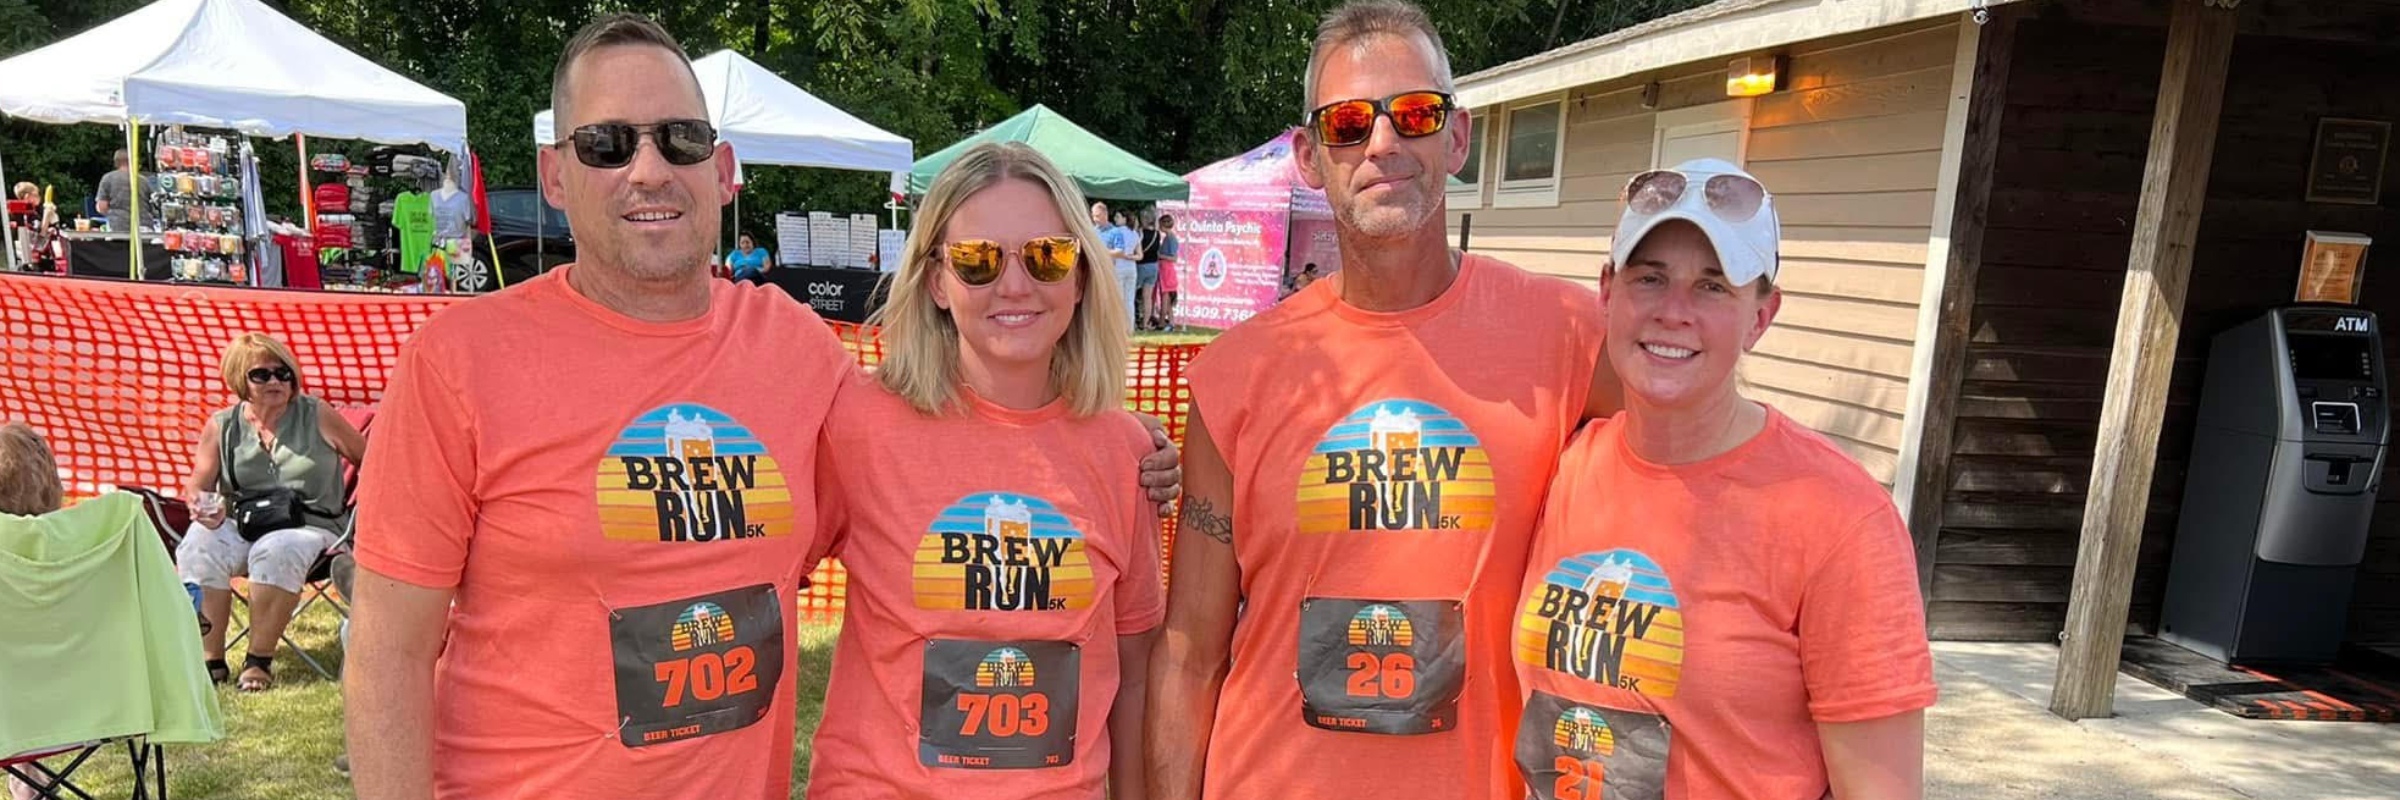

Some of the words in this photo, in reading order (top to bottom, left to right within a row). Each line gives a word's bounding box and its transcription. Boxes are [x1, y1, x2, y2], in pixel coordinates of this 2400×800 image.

[1190, 220, 1223, 232] Quinta
[1225, 220, 1261, 237] Psychic
[808, 281, 844, 296] color
[810, 298, 845, 311] STREET
[2334, 316, 2368, 332] ATM
[621, 455, 757, 490] BREW
[1325, 447, 1465, 484] BREW
[654, 490, 746, 542] RUN
[747, 524, 765, 537] 5K
[1350, 481, 1440, 530] RUN
[1440, 516, 1460, 529] 5K
[941, 532, 1072, 567] BREW
[965, 564, 1050, 611] RUN
[1049, 598, 1067, 610] 5K
[1538, 584, 1661, 639] BREW
[1546, 620, 1626, 688] RUN
[1619, 676, 1640, 692] 5K
[655, 646, 757, 707] 702
[1347, 652, 1415, 699] 26
[670, 725, 700, 737] TICKET
[957, 693, 1049, 737] 703
[1339, 718, 1367, 728] TICKET
[962, 756, 990, 766] TICKET
[1554, 756, 1604, 800] 21
